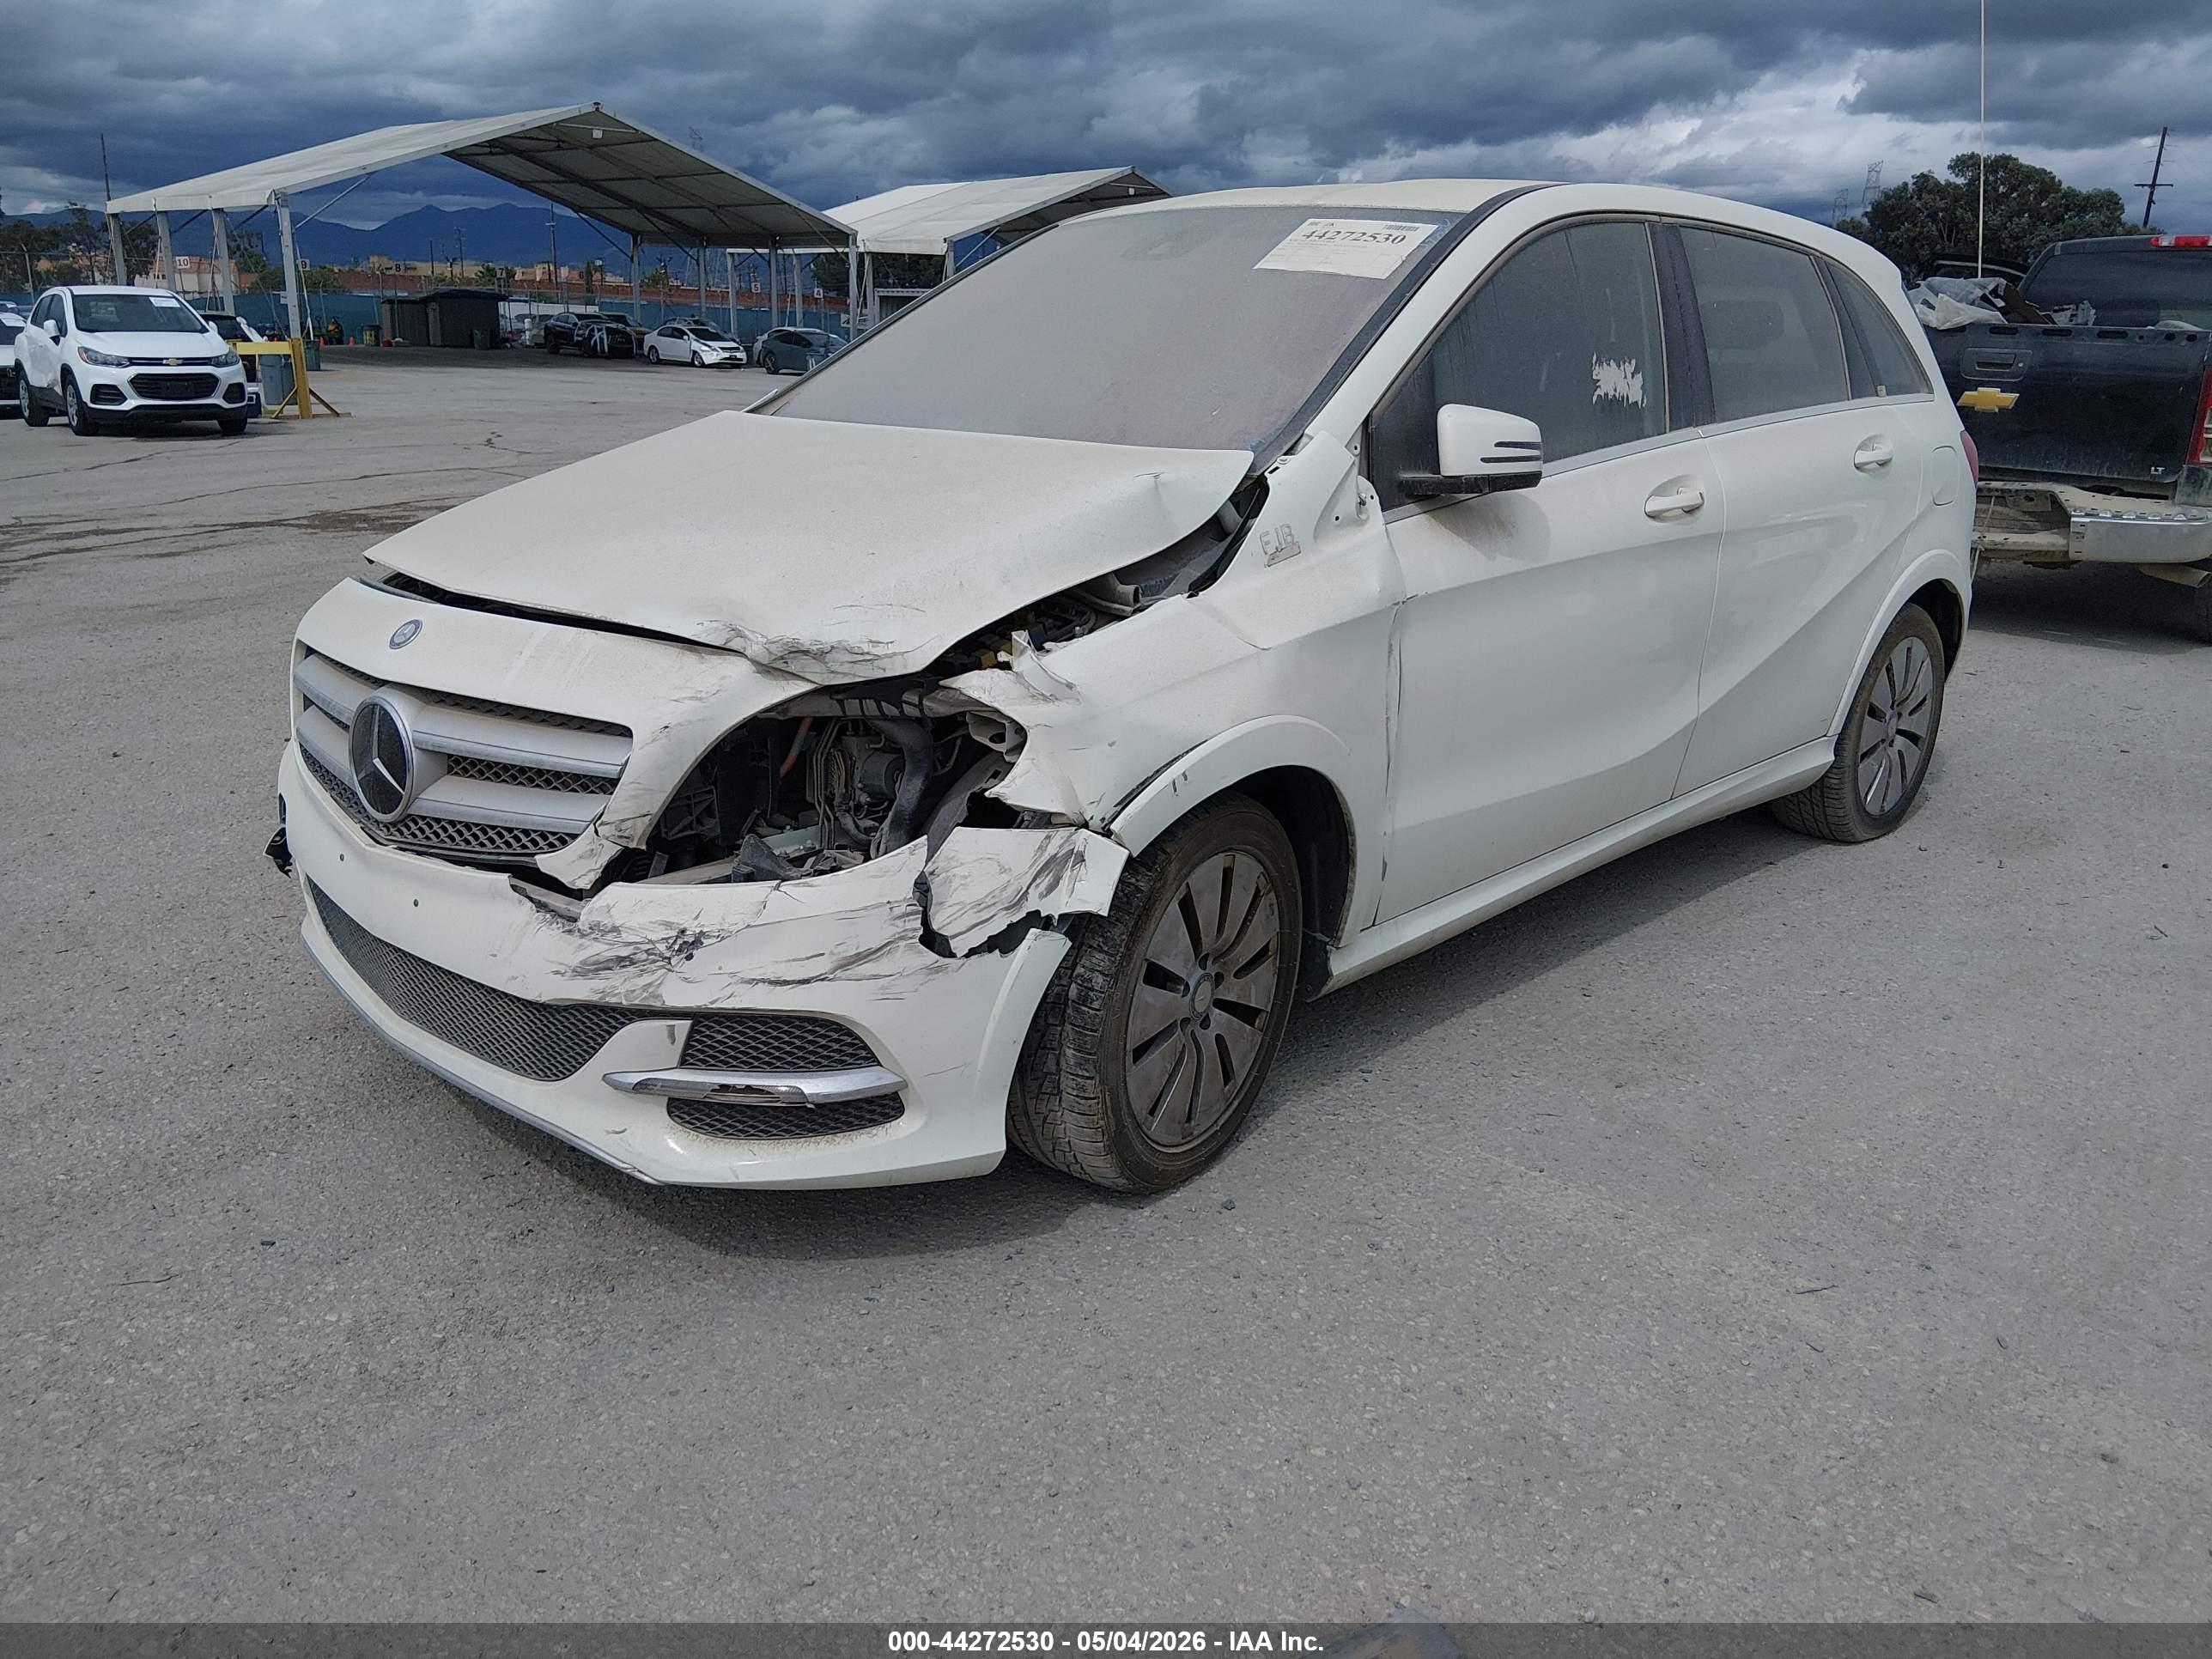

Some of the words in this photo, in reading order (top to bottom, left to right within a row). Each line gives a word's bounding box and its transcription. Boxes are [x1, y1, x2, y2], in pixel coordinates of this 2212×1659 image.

[1301, 228, 1407, 246] 44272530
[177, 258, 189, 267] 10
[301, 260, 307, 269] 9
[395, 263, 401, 272] 8
[498, 267, 504, 276] 7
[2150, 466, 2166, 475] LT
